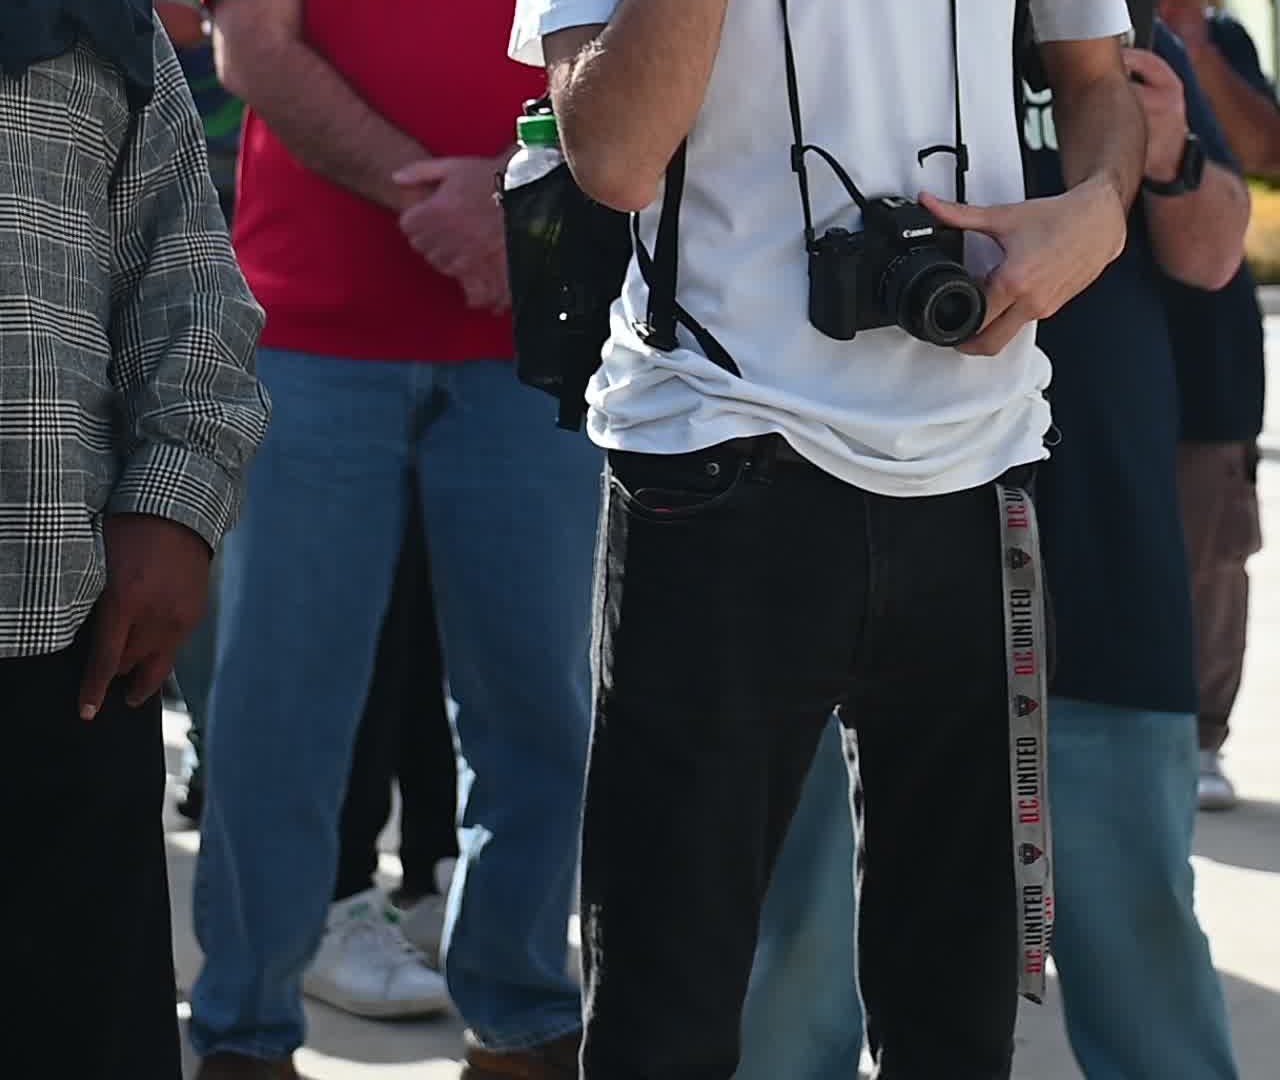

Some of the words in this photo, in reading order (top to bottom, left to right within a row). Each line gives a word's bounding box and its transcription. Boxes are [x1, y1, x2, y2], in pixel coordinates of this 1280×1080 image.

[1010, 589, 1034, 648] UNITED
[1016, 736, 1040, 796] UNITED
[1023, 884, 1043, 946] UNITED
